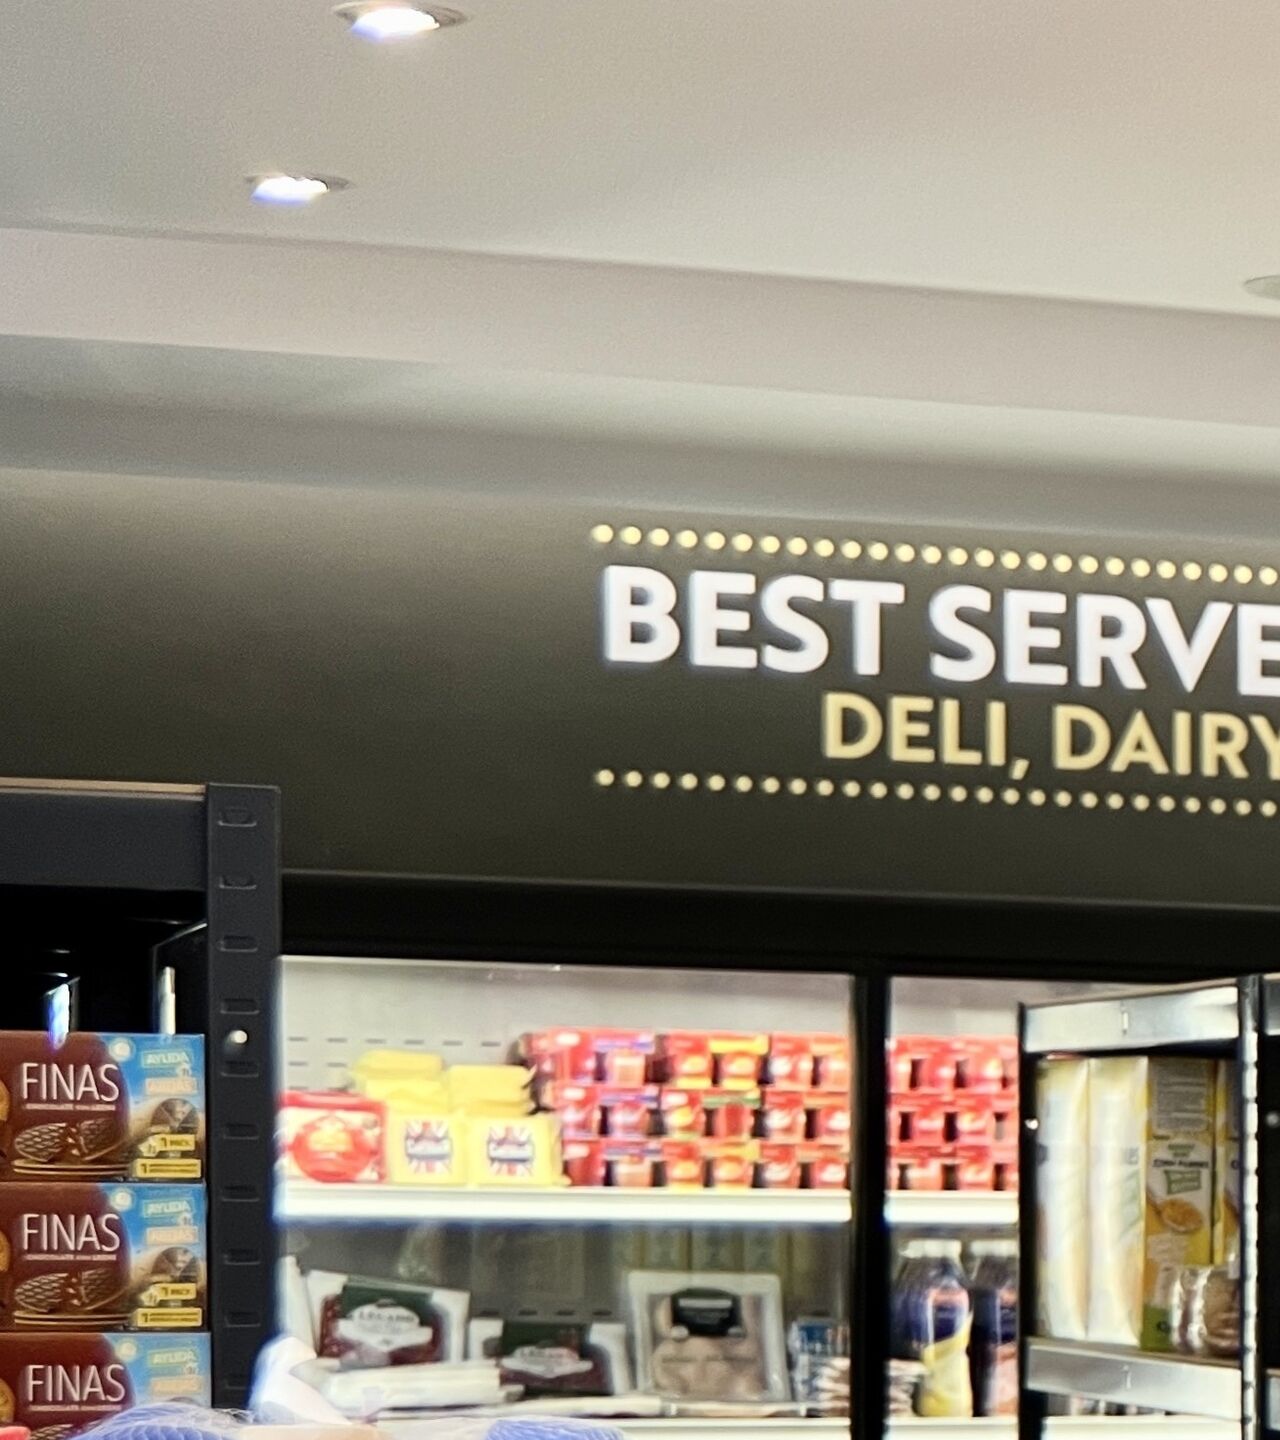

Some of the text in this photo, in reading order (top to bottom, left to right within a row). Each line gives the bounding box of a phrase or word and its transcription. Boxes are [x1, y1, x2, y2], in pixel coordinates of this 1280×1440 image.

[602, 563, 907, 677] BEST
[821, 691, 1030, 780] DELI,
[20, 1061, 120, 1103] FINAS
[21, 1212, 121, 1253] FINAS
[26, 1363, 126, 1403] FINAS
